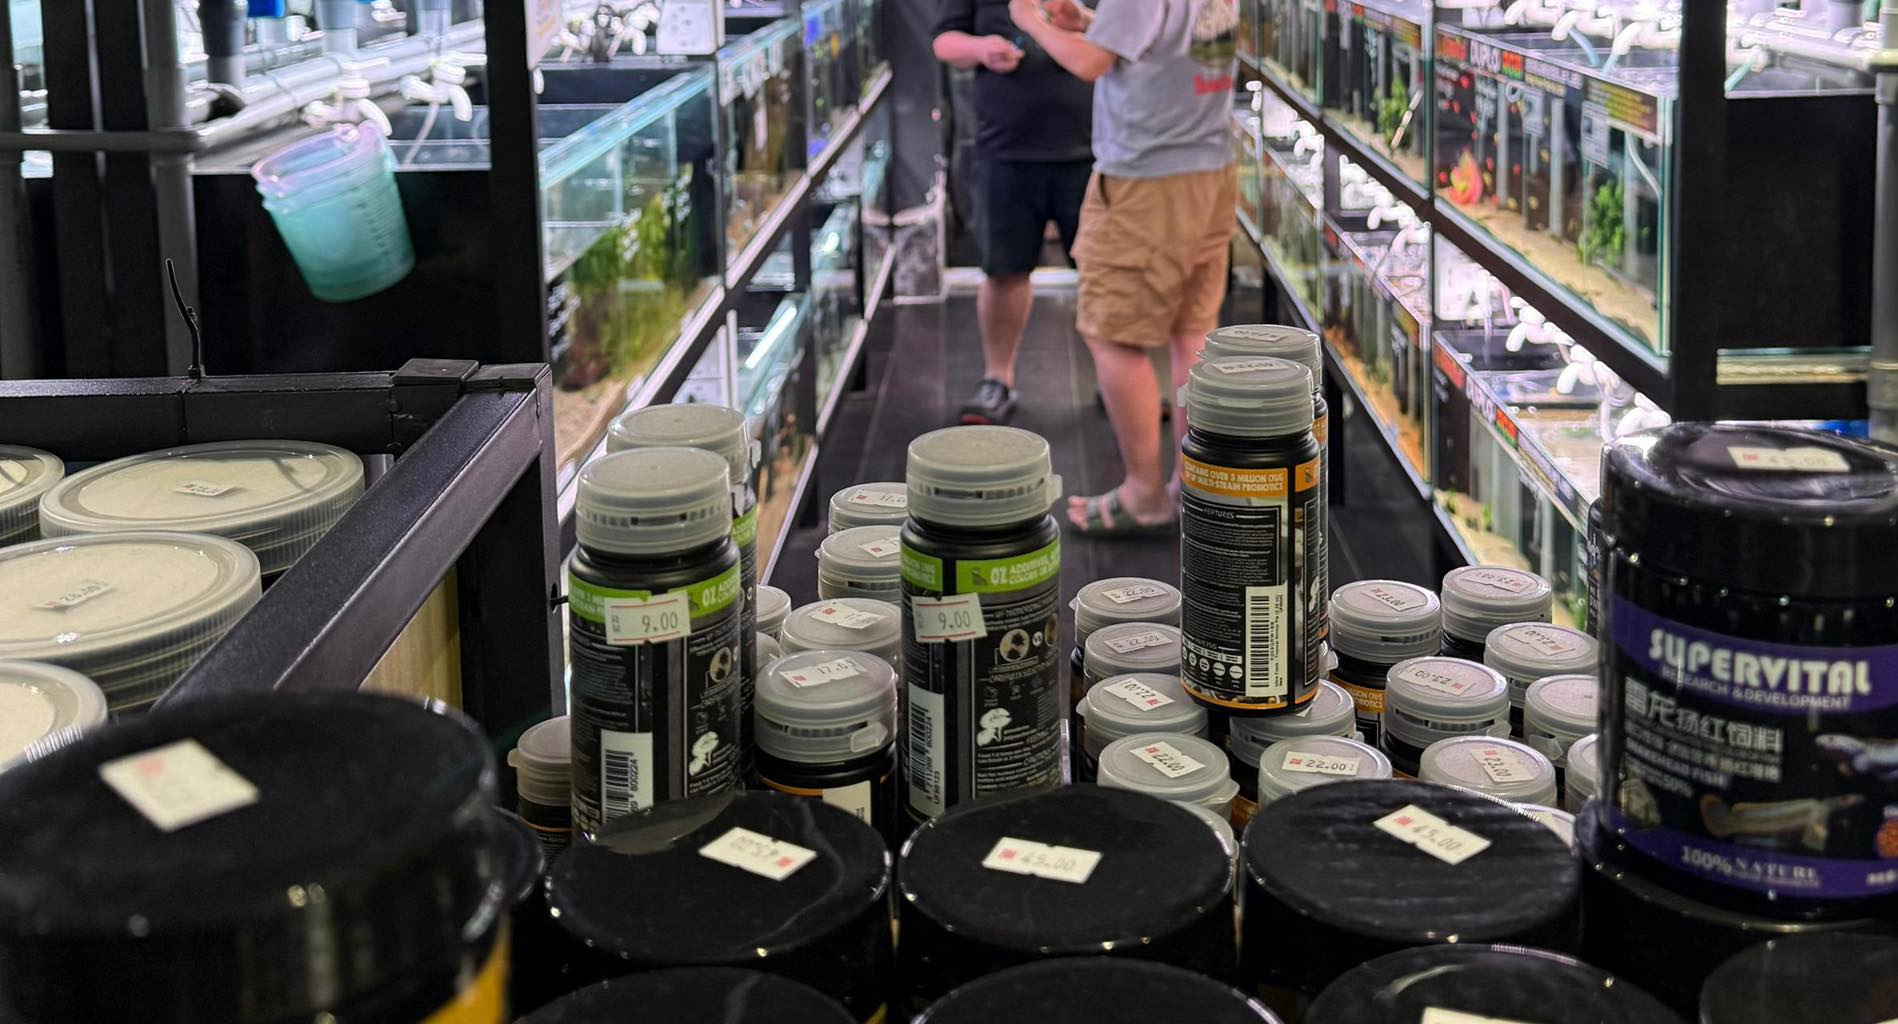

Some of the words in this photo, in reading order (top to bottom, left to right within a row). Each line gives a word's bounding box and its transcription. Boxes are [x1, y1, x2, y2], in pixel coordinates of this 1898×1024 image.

[1210, 470, 1229, 483] OVER
[1237, 474, 1267, 483] MILLION
[1243, 483, 1284, 493] PROBIOTICS
[641, 611, 679, 633] 9.00
[938, 610, 971, 630] 9.00
[1649, 628, 1873, 695] SUPERVITAL
[1415, 670, 1453, 685] 23.00
[1662, 666, 1729, 696] REEARCH
[1151, 753, 1185, 771] 22.00
[1305, 759, 1346, 771] 22.00
[1484, 757, 1512, 777] 23.00
[630, 759, 639, 791] 800224
[1412, 824, 1463, 852] 45.00
[1681, 845, 1732, 875] 100%
